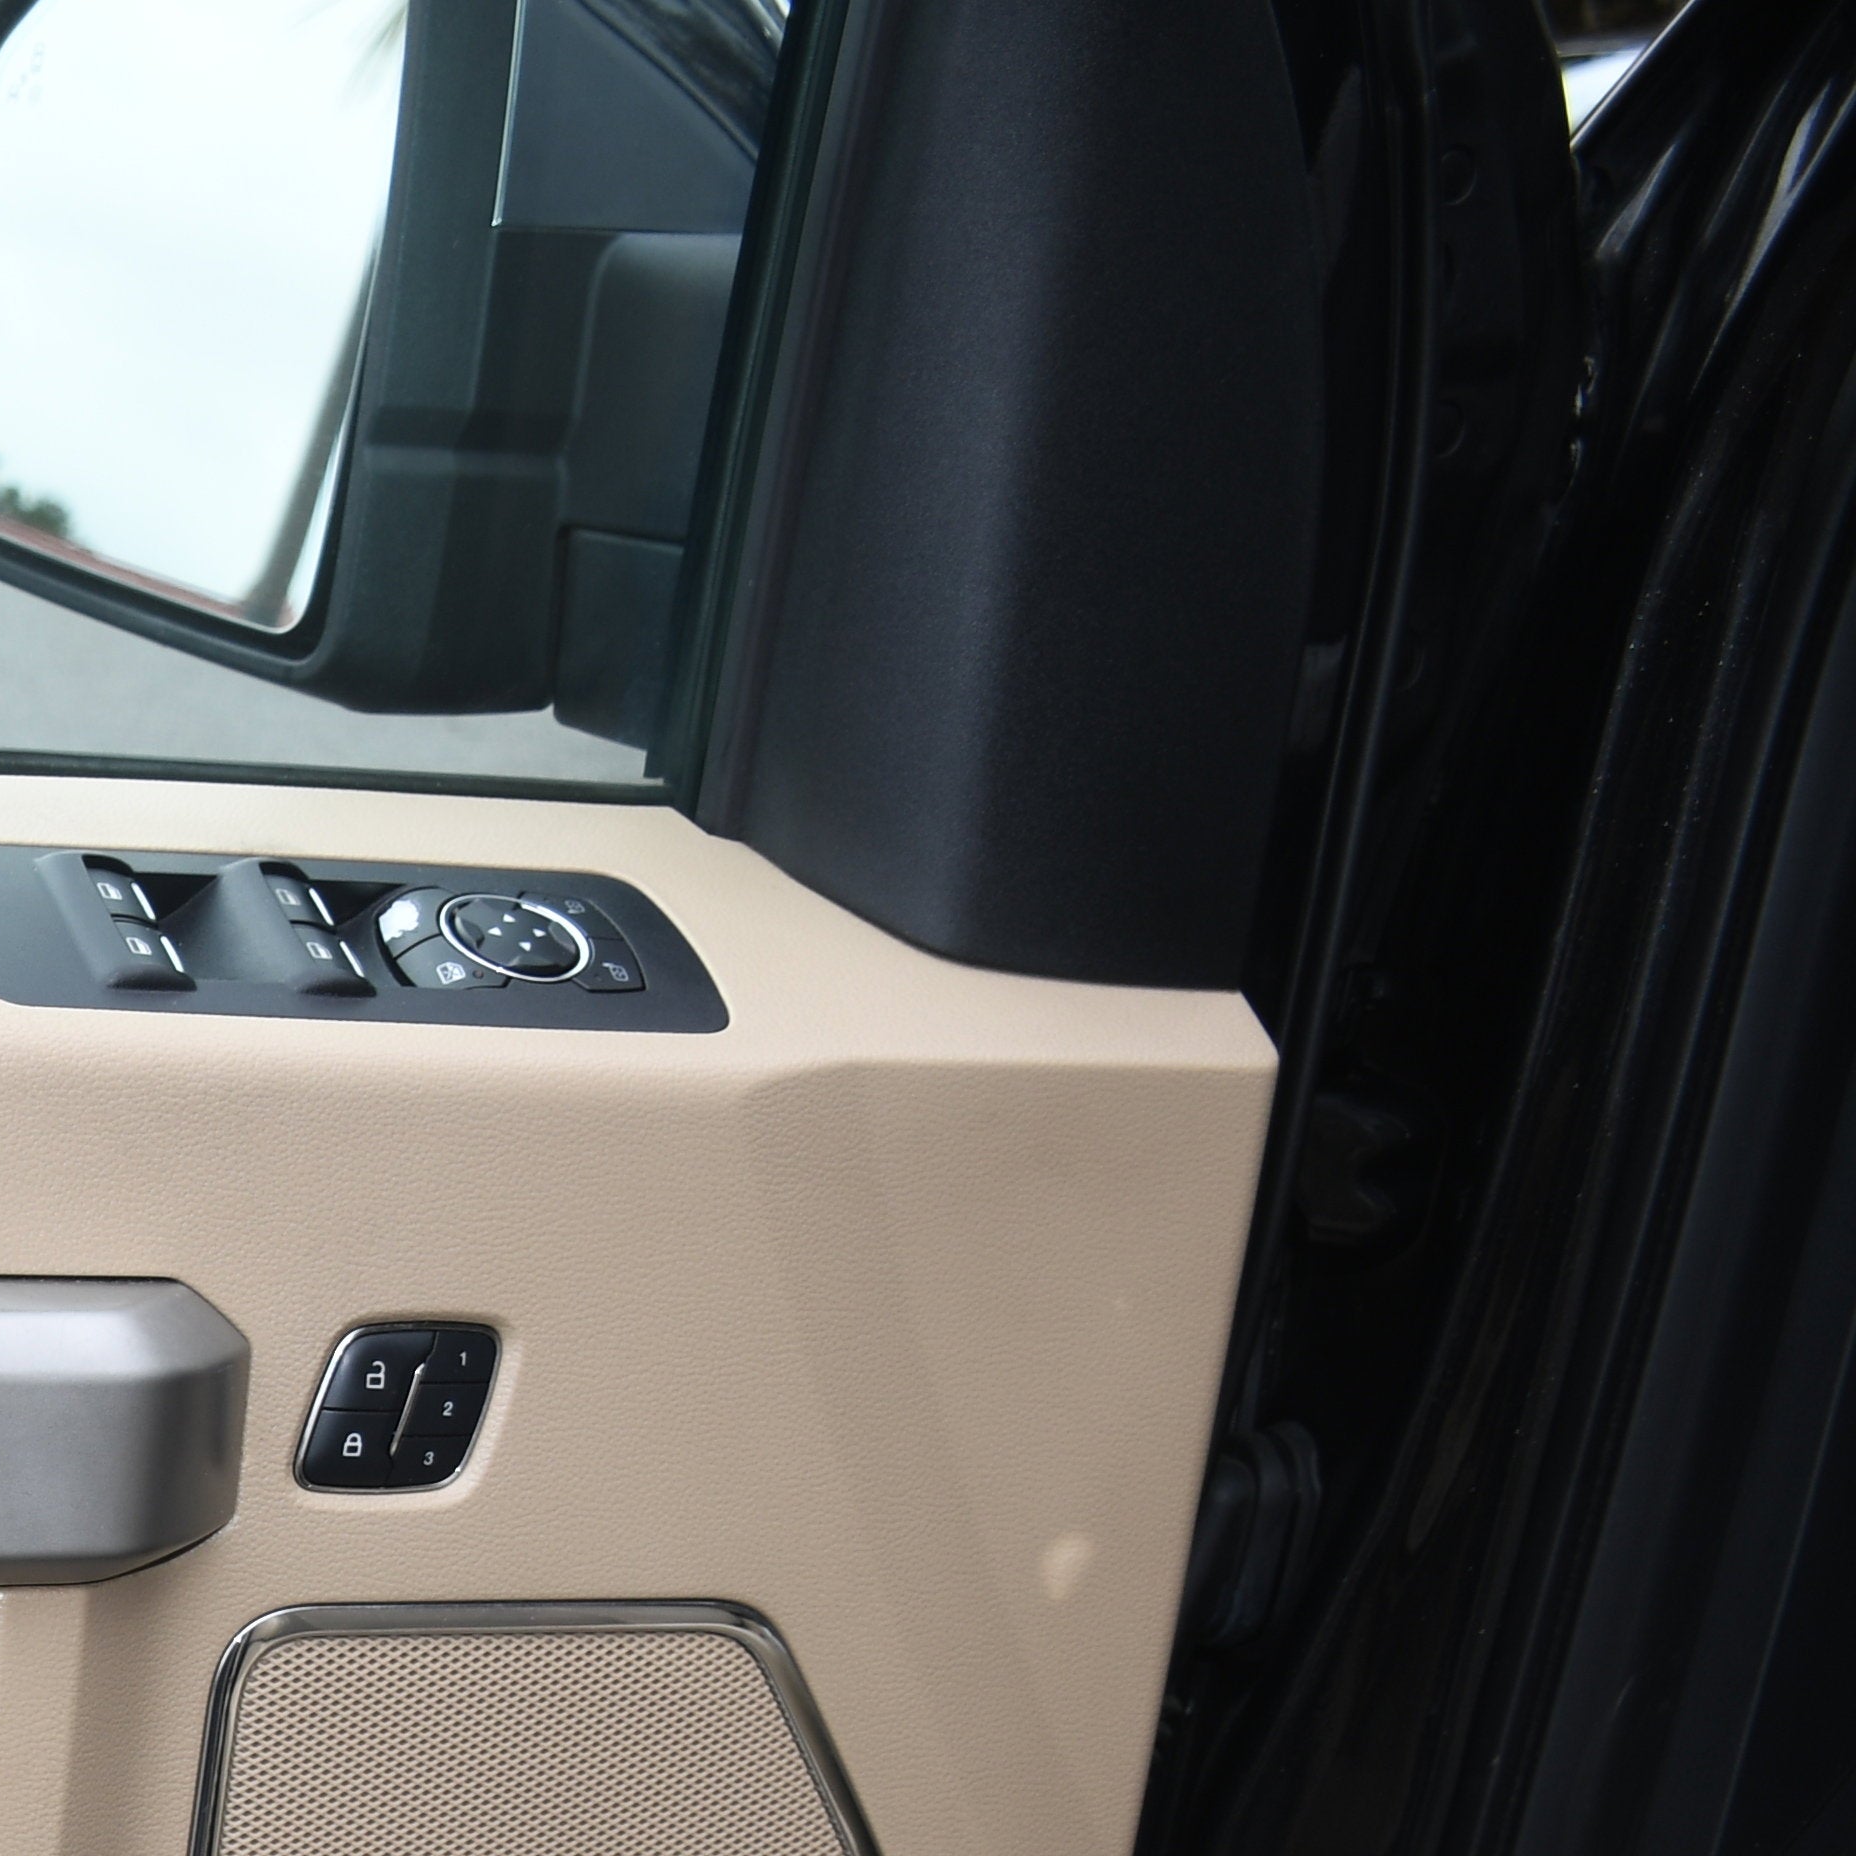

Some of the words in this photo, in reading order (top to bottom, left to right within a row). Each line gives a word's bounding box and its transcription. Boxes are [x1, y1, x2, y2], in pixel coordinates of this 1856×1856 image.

[459, 1352, 467, 1366] 1
[442, 1402, 454, 1417] 2
[423, 1452, 434, 1466] 3
